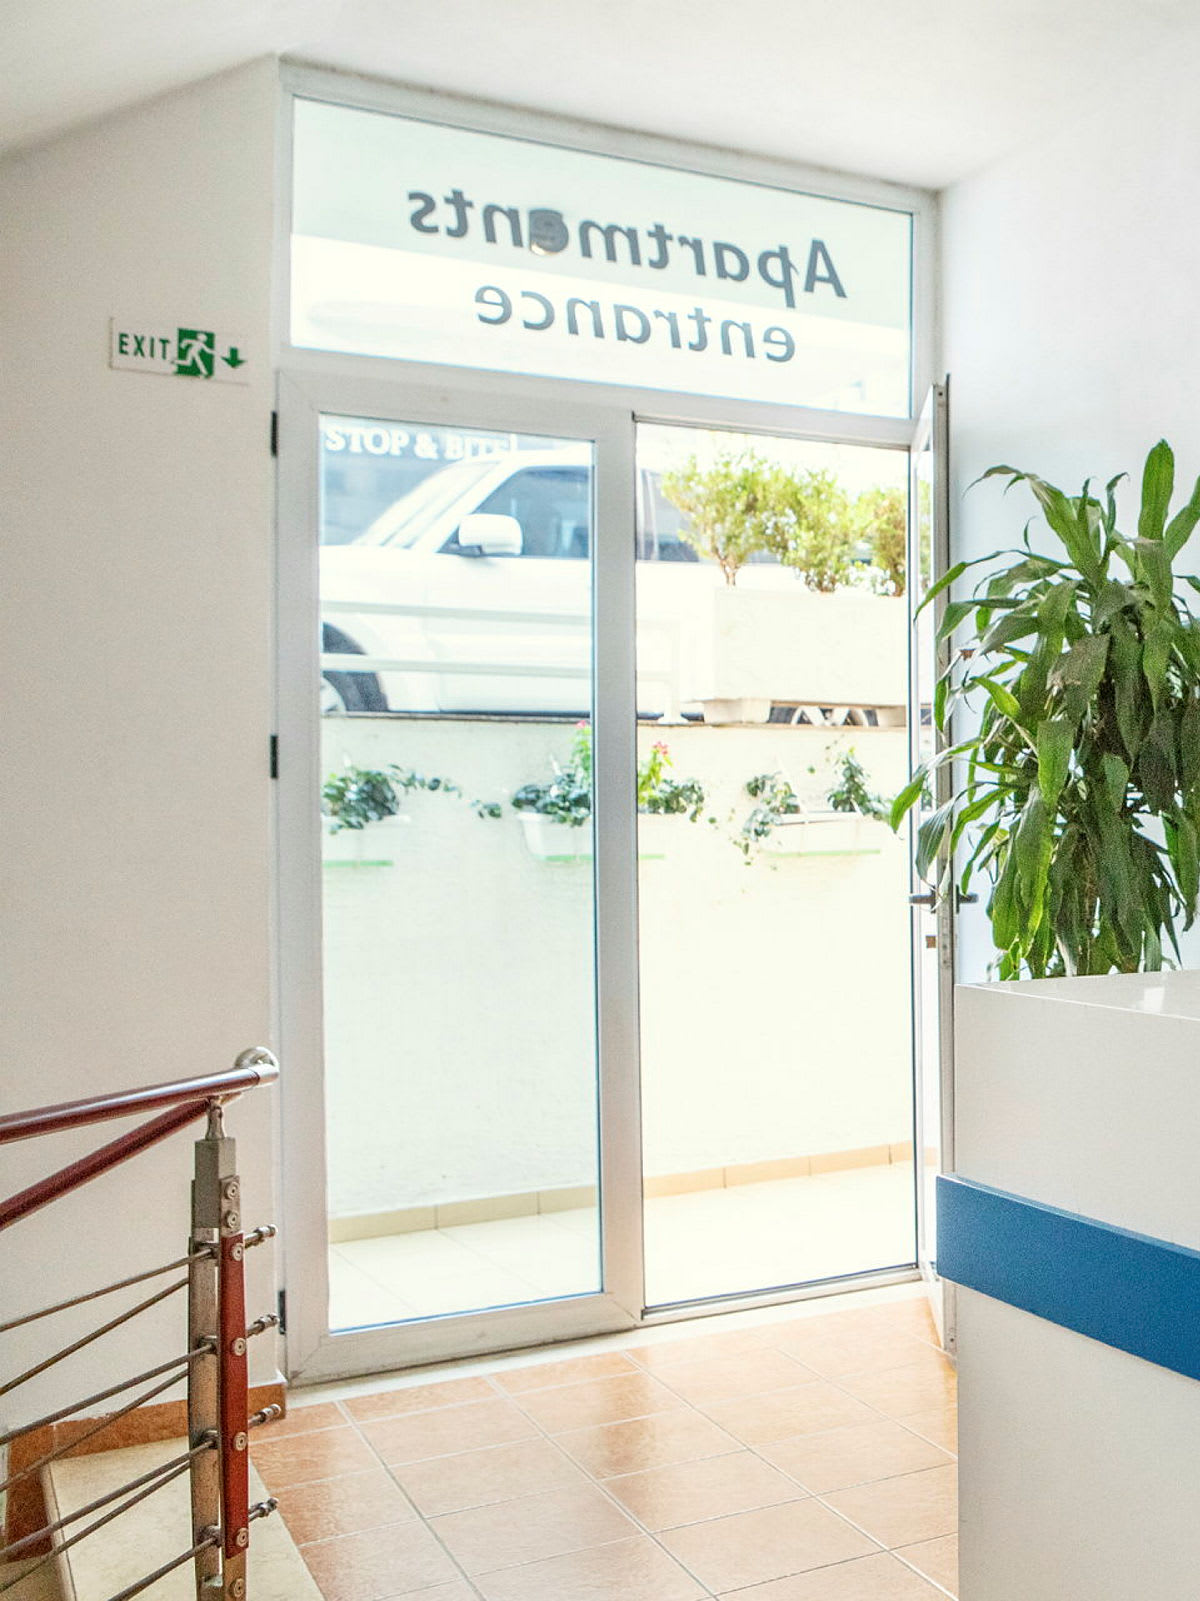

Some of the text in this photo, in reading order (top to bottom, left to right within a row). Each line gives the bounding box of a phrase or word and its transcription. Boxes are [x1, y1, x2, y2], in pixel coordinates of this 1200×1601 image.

[118, 332, 171, 360] EXIT
[325, 426, 410, 455] STOP
[414, 431, 438, 459] &
